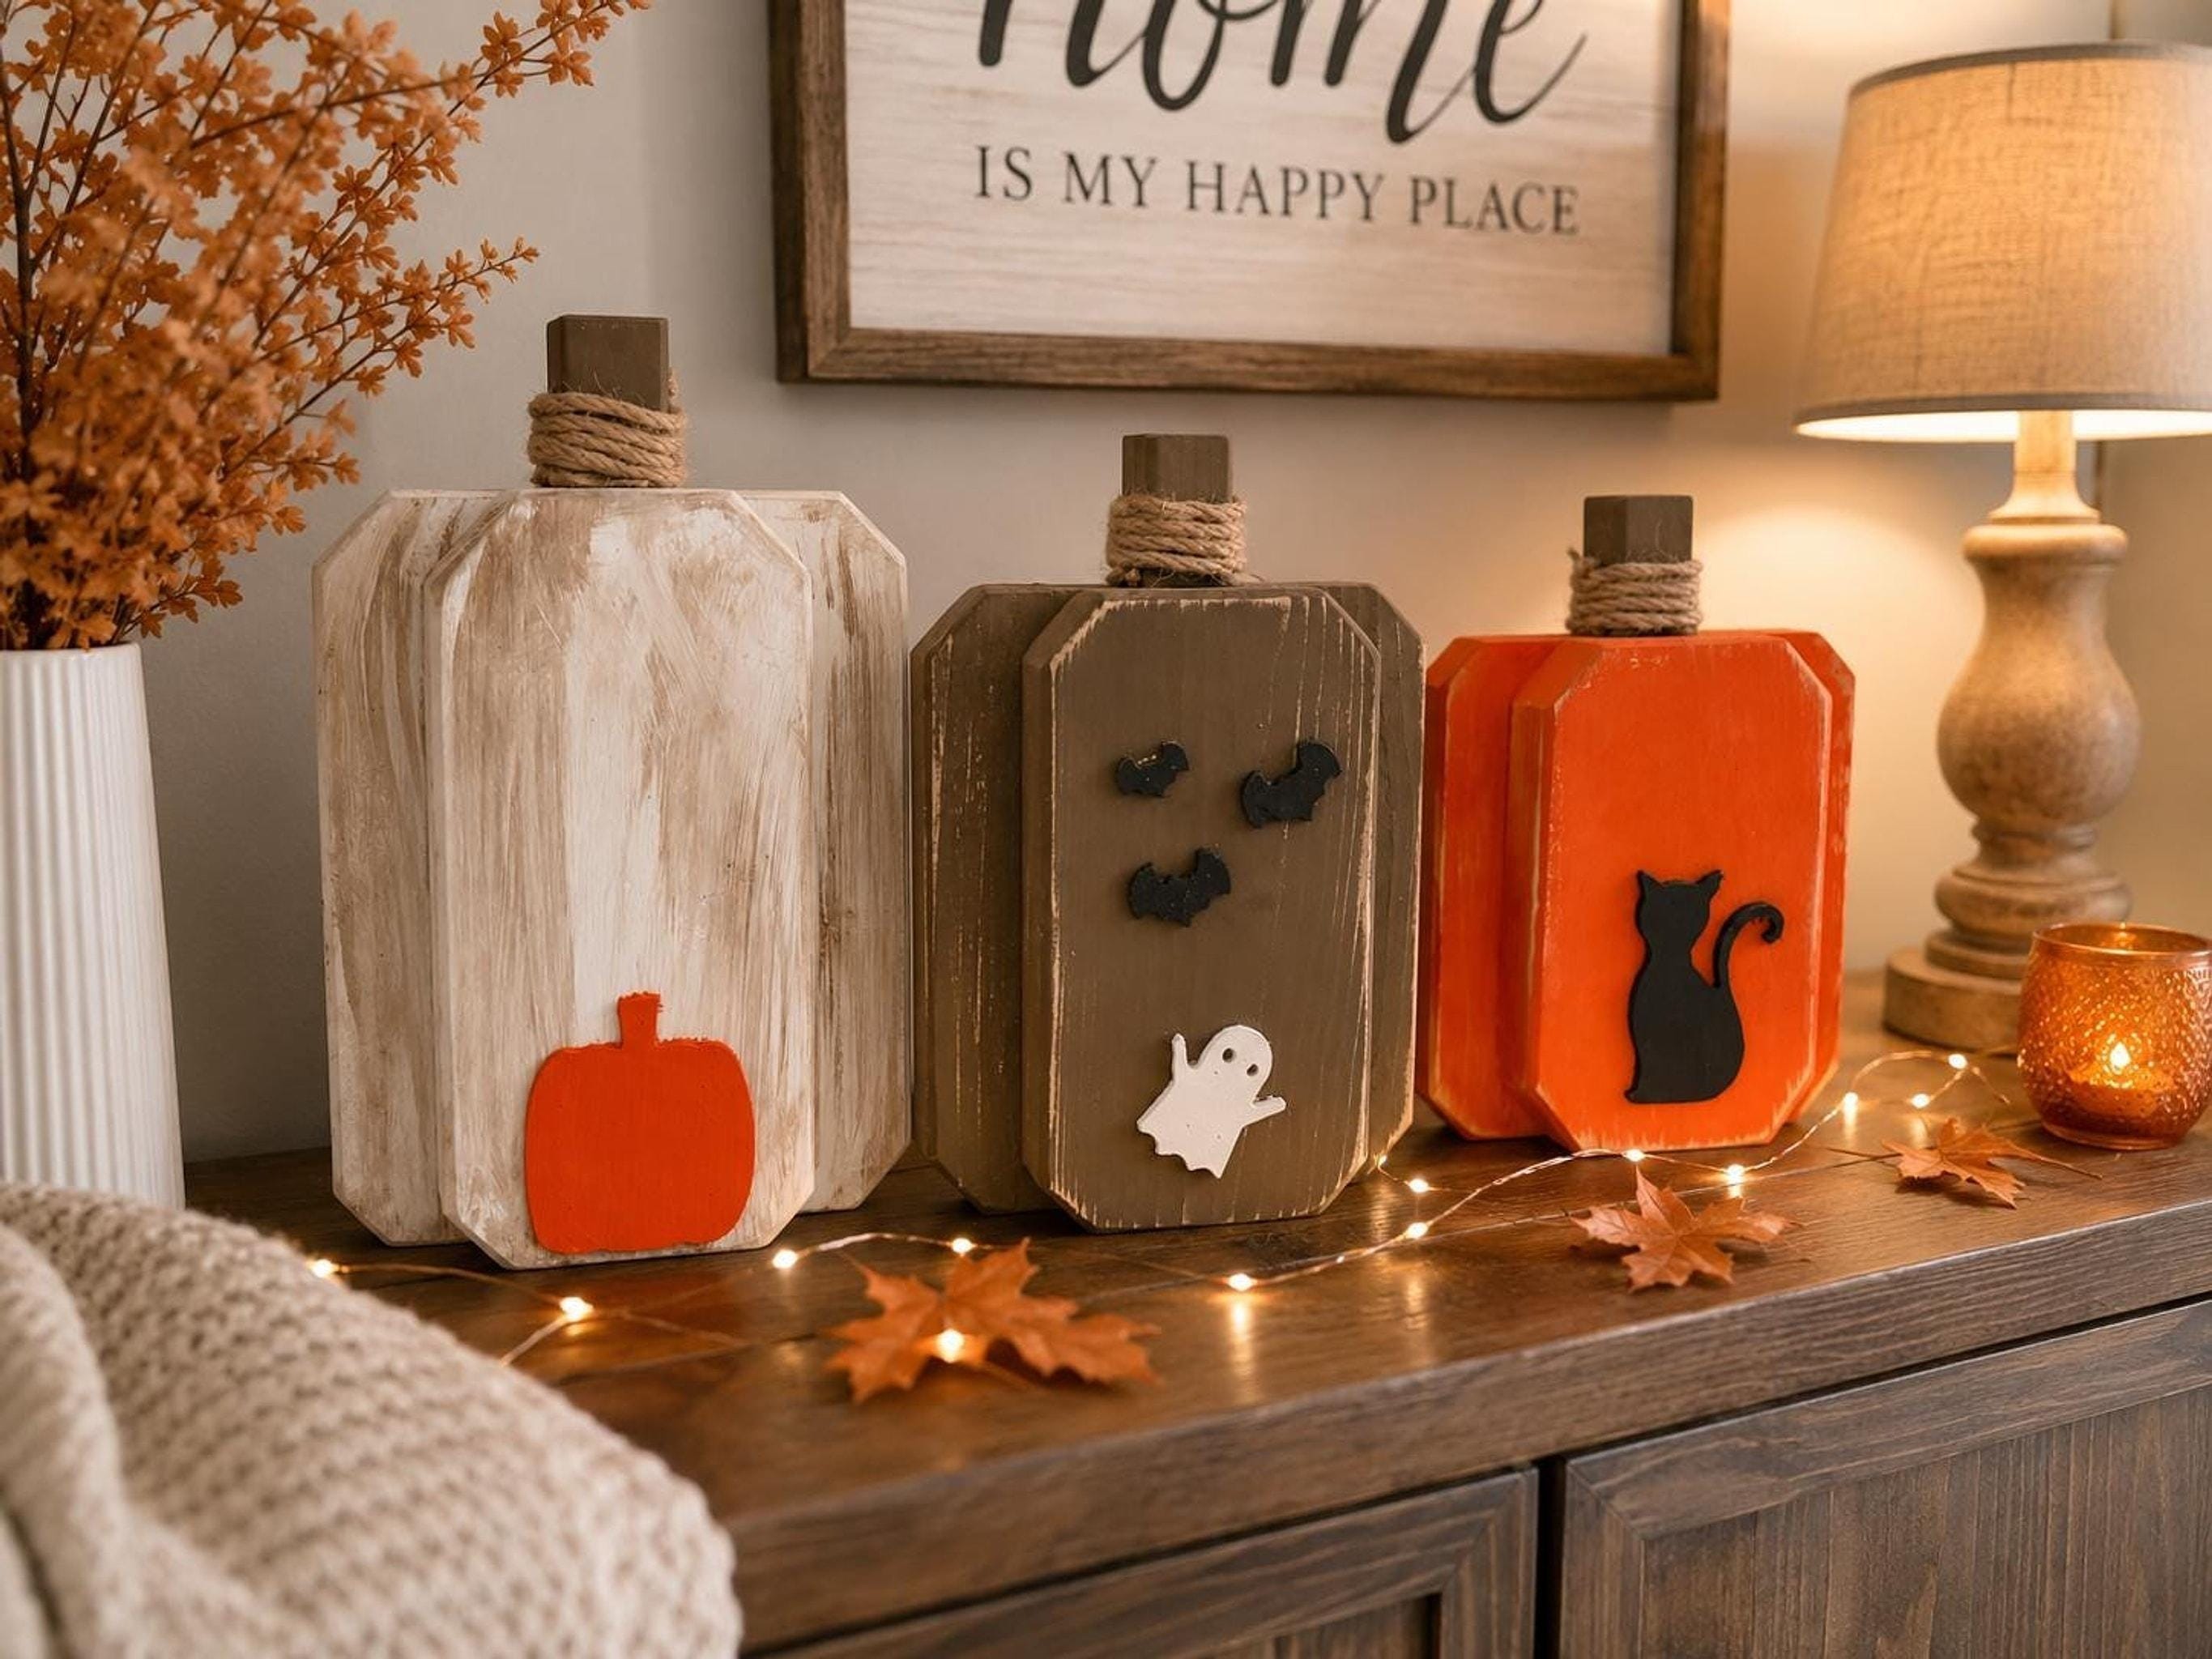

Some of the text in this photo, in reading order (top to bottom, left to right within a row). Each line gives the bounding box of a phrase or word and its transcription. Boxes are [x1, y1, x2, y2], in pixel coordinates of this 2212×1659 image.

[977, 146, 1579, 235] IS MY HAPPY PLACE
